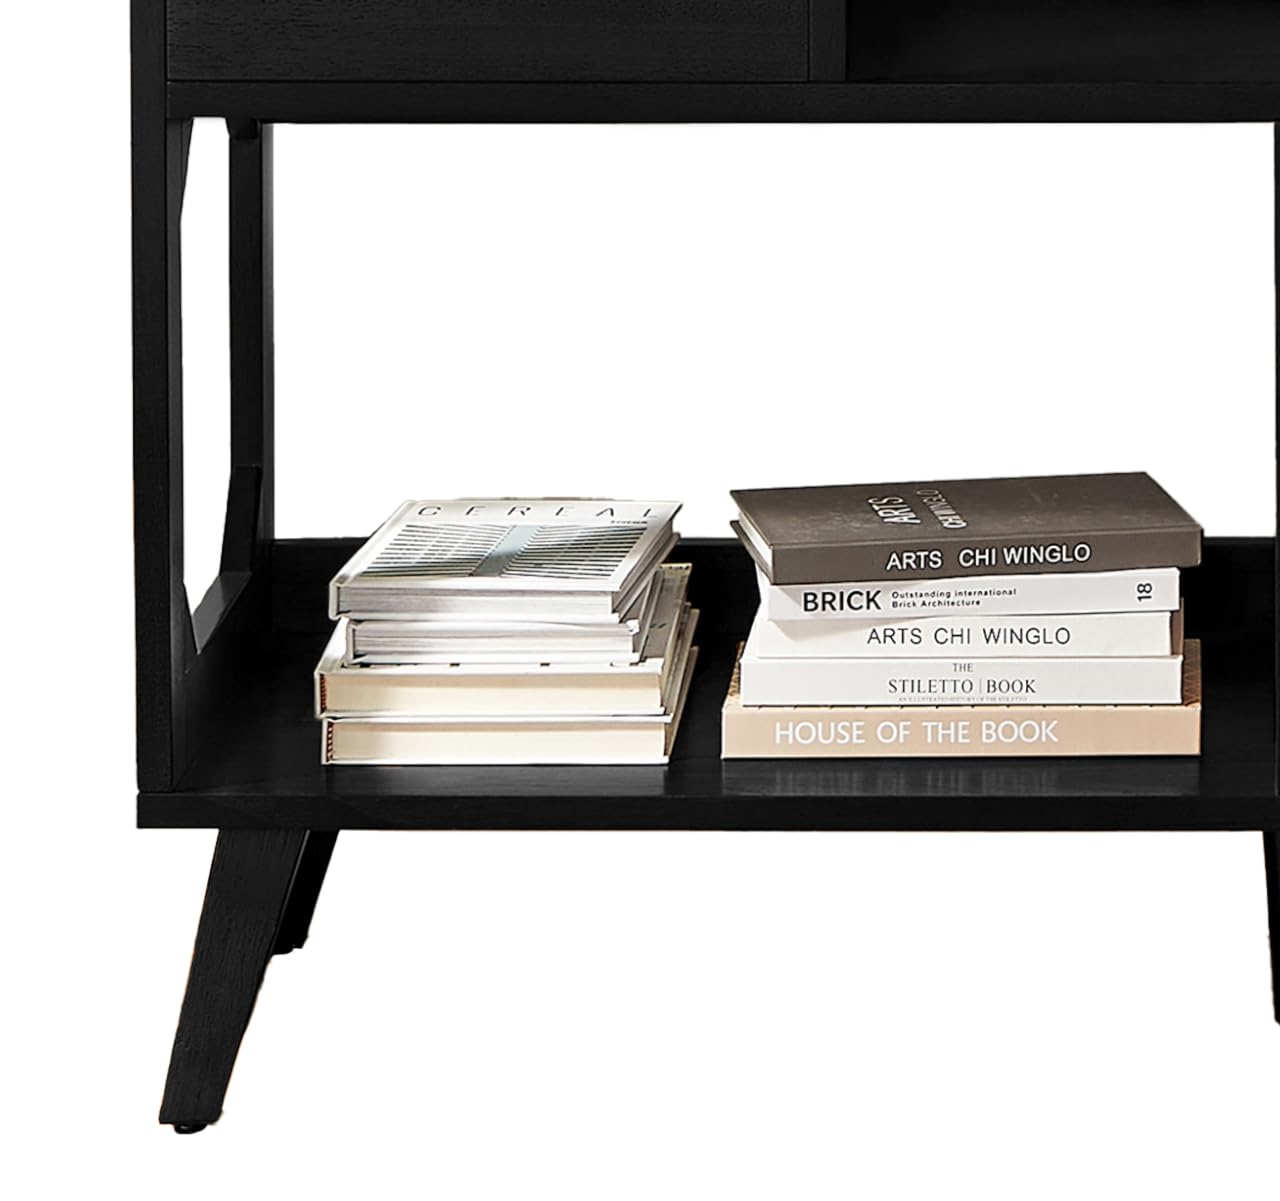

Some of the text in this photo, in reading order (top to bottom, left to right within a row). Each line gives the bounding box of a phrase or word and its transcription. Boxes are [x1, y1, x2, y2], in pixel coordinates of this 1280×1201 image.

[418, 506, 657, 518] CEREAL
[867, 496, 921, 524] ARTS
[886, 544, 1091, 571] ARTS CHI WINGLO
[802, 590, 882, 613] BRICK
[892, 591, 951, 599] Outstanding
[1137, 583, 1153, 602] 18
[867, 627, 1071, 645] ARTS CHI WINGLO
[953, 663, 974, 672] THE
[888, 678, 1037, 694] STILETTO BOOK
[775, 719, 1059, 744] HOUSE OF THE BOOK
